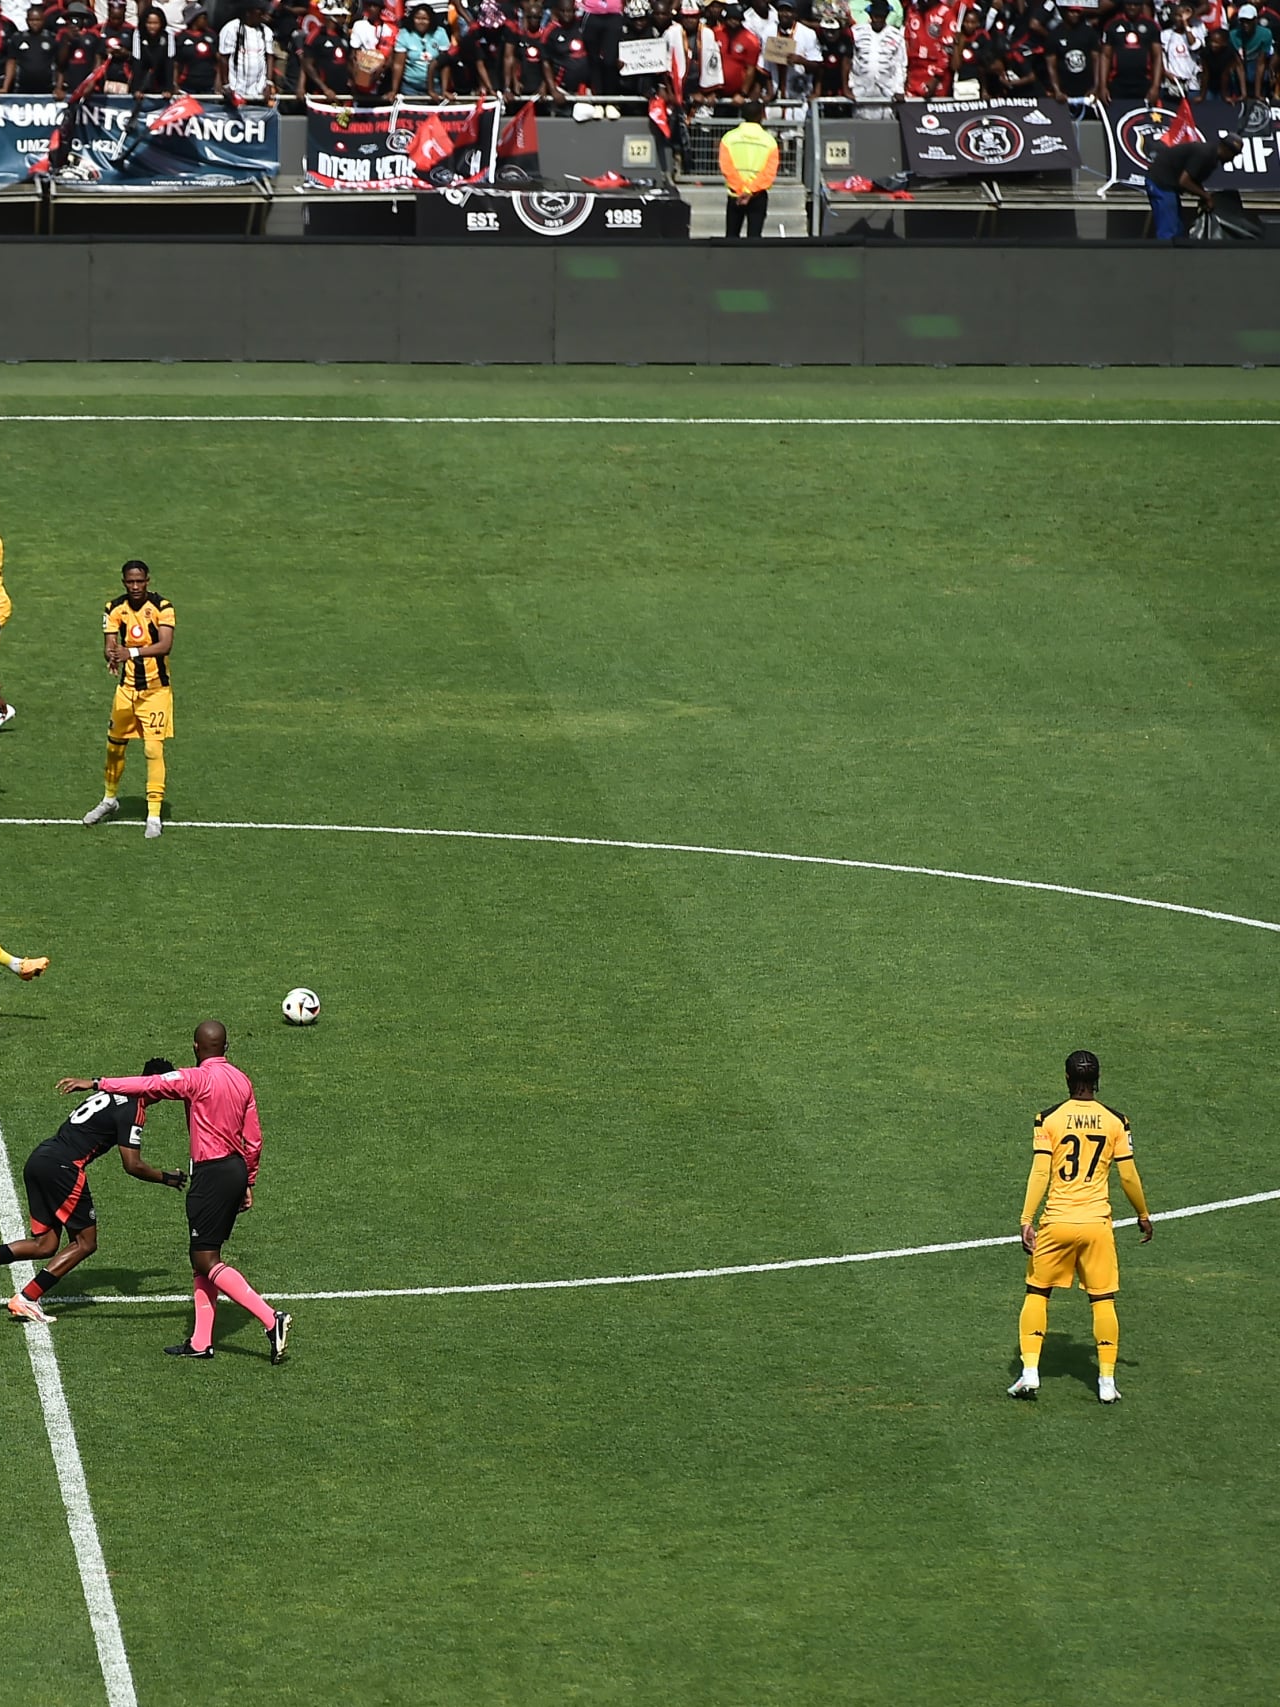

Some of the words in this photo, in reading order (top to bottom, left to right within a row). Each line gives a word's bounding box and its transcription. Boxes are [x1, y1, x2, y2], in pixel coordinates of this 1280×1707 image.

[926, 103, 988, 113] PINETOWN
[990, 97, 1038, 108] BRANCH
[631, 145, 648, 156] 127
[829, 147, 847, 157] 128
[467, 213, 500, 227] EST.
[605, 209, 642, 225] 1985
[150, 712, 165, 728] 22
[1066, 1115, 1102, 1130] ZWANE
[1059, 1134, 1107, 1182] 37
